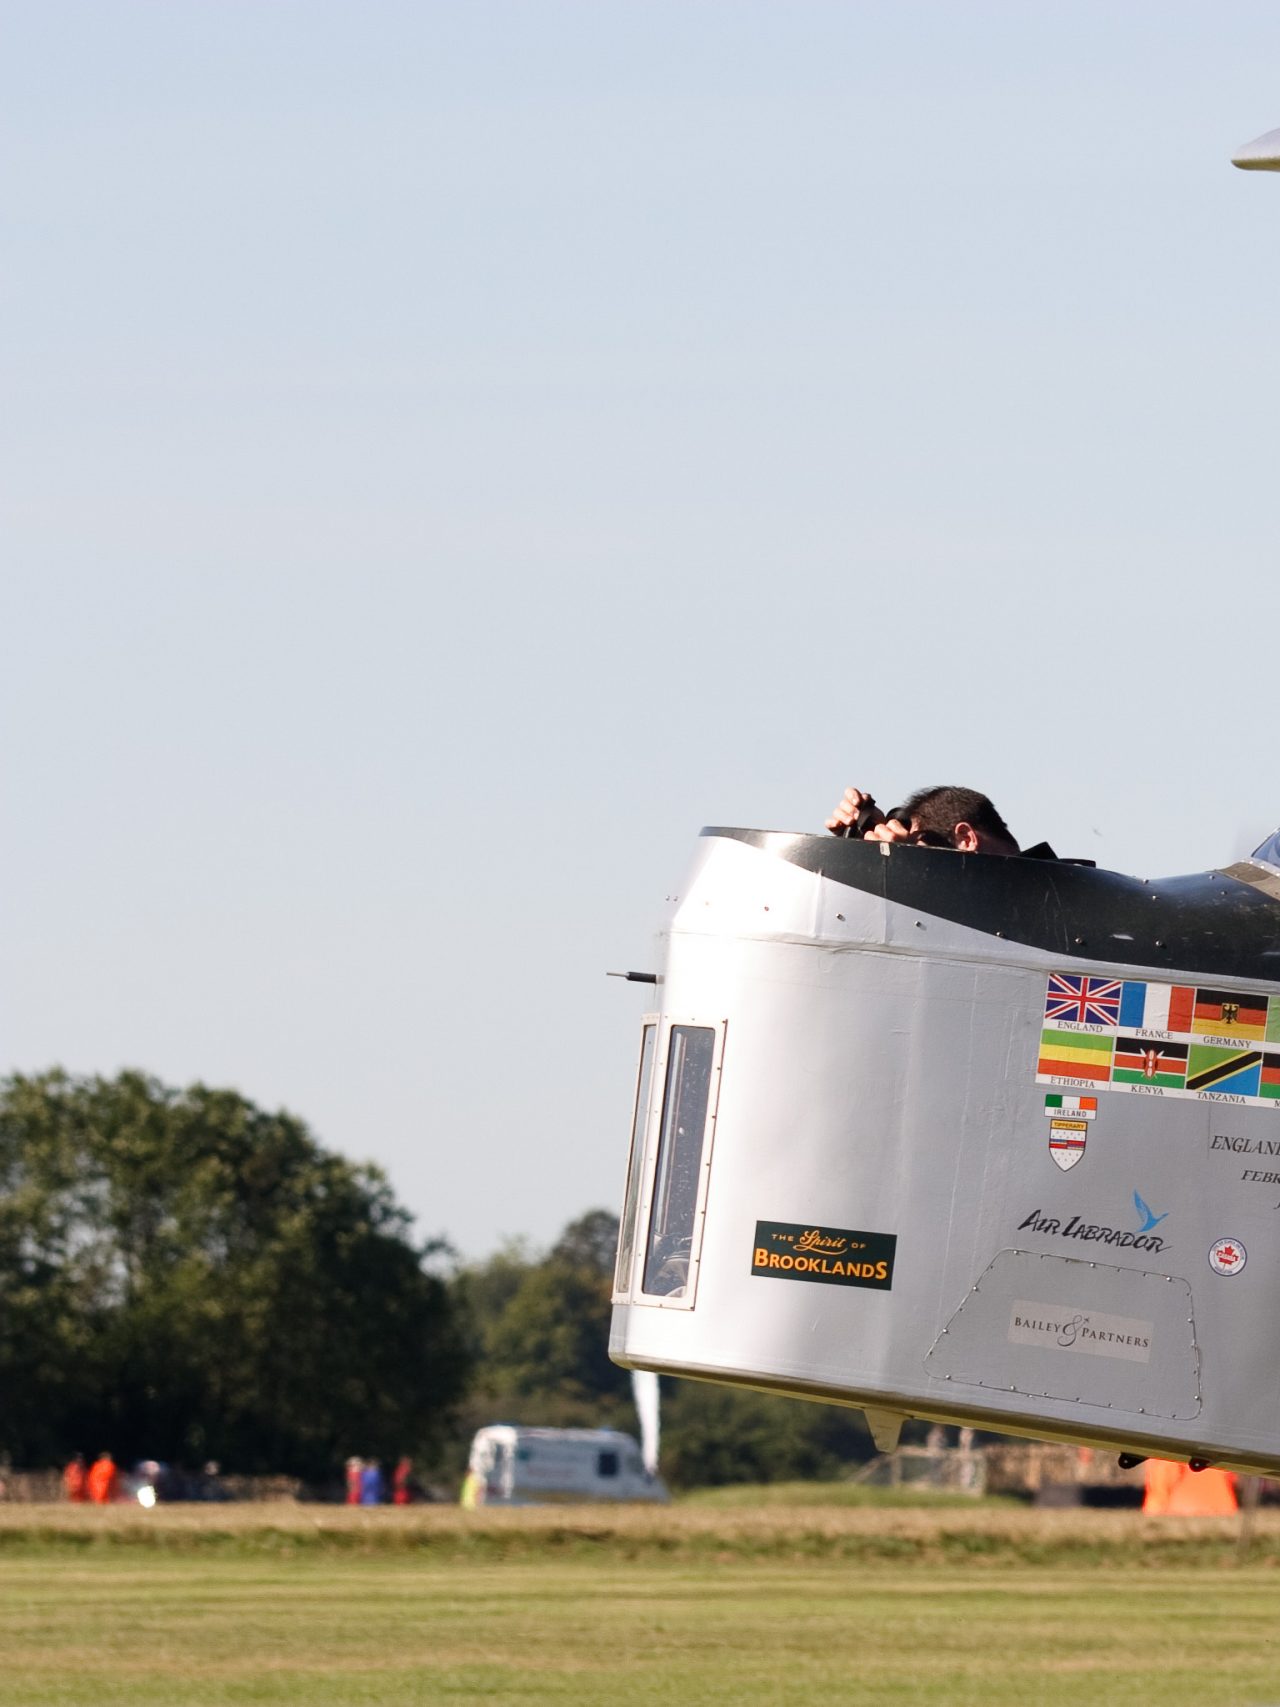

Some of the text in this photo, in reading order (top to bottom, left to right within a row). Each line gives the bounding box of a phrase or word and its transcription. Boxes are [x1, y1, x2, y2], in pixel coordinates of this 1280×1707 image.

[1057, 1021, 1103, 1033] ENGLAND
[1135, 1029, 1173, 1039] FRANCE
[1203, 1036, 1251, 1048] GERMANY
[1050, 1076, 1095, 1088] ETHIOPIA
[1131, 1085, 1164, 1095] KENYA
[1196, 1092, 1246, 1104] TANZANIA
[1054, 1108, 1087, 1117] IRELAND
[1017, 1209, 1173, 1254] AIR LABRADOR
[771, 1229, 867, 1255] THE Spirit OF
[753, 1248, 888, 1281] BROOKLANDS
[1014, 1314, 1149, 1348] BAILEY & PARTNERS
